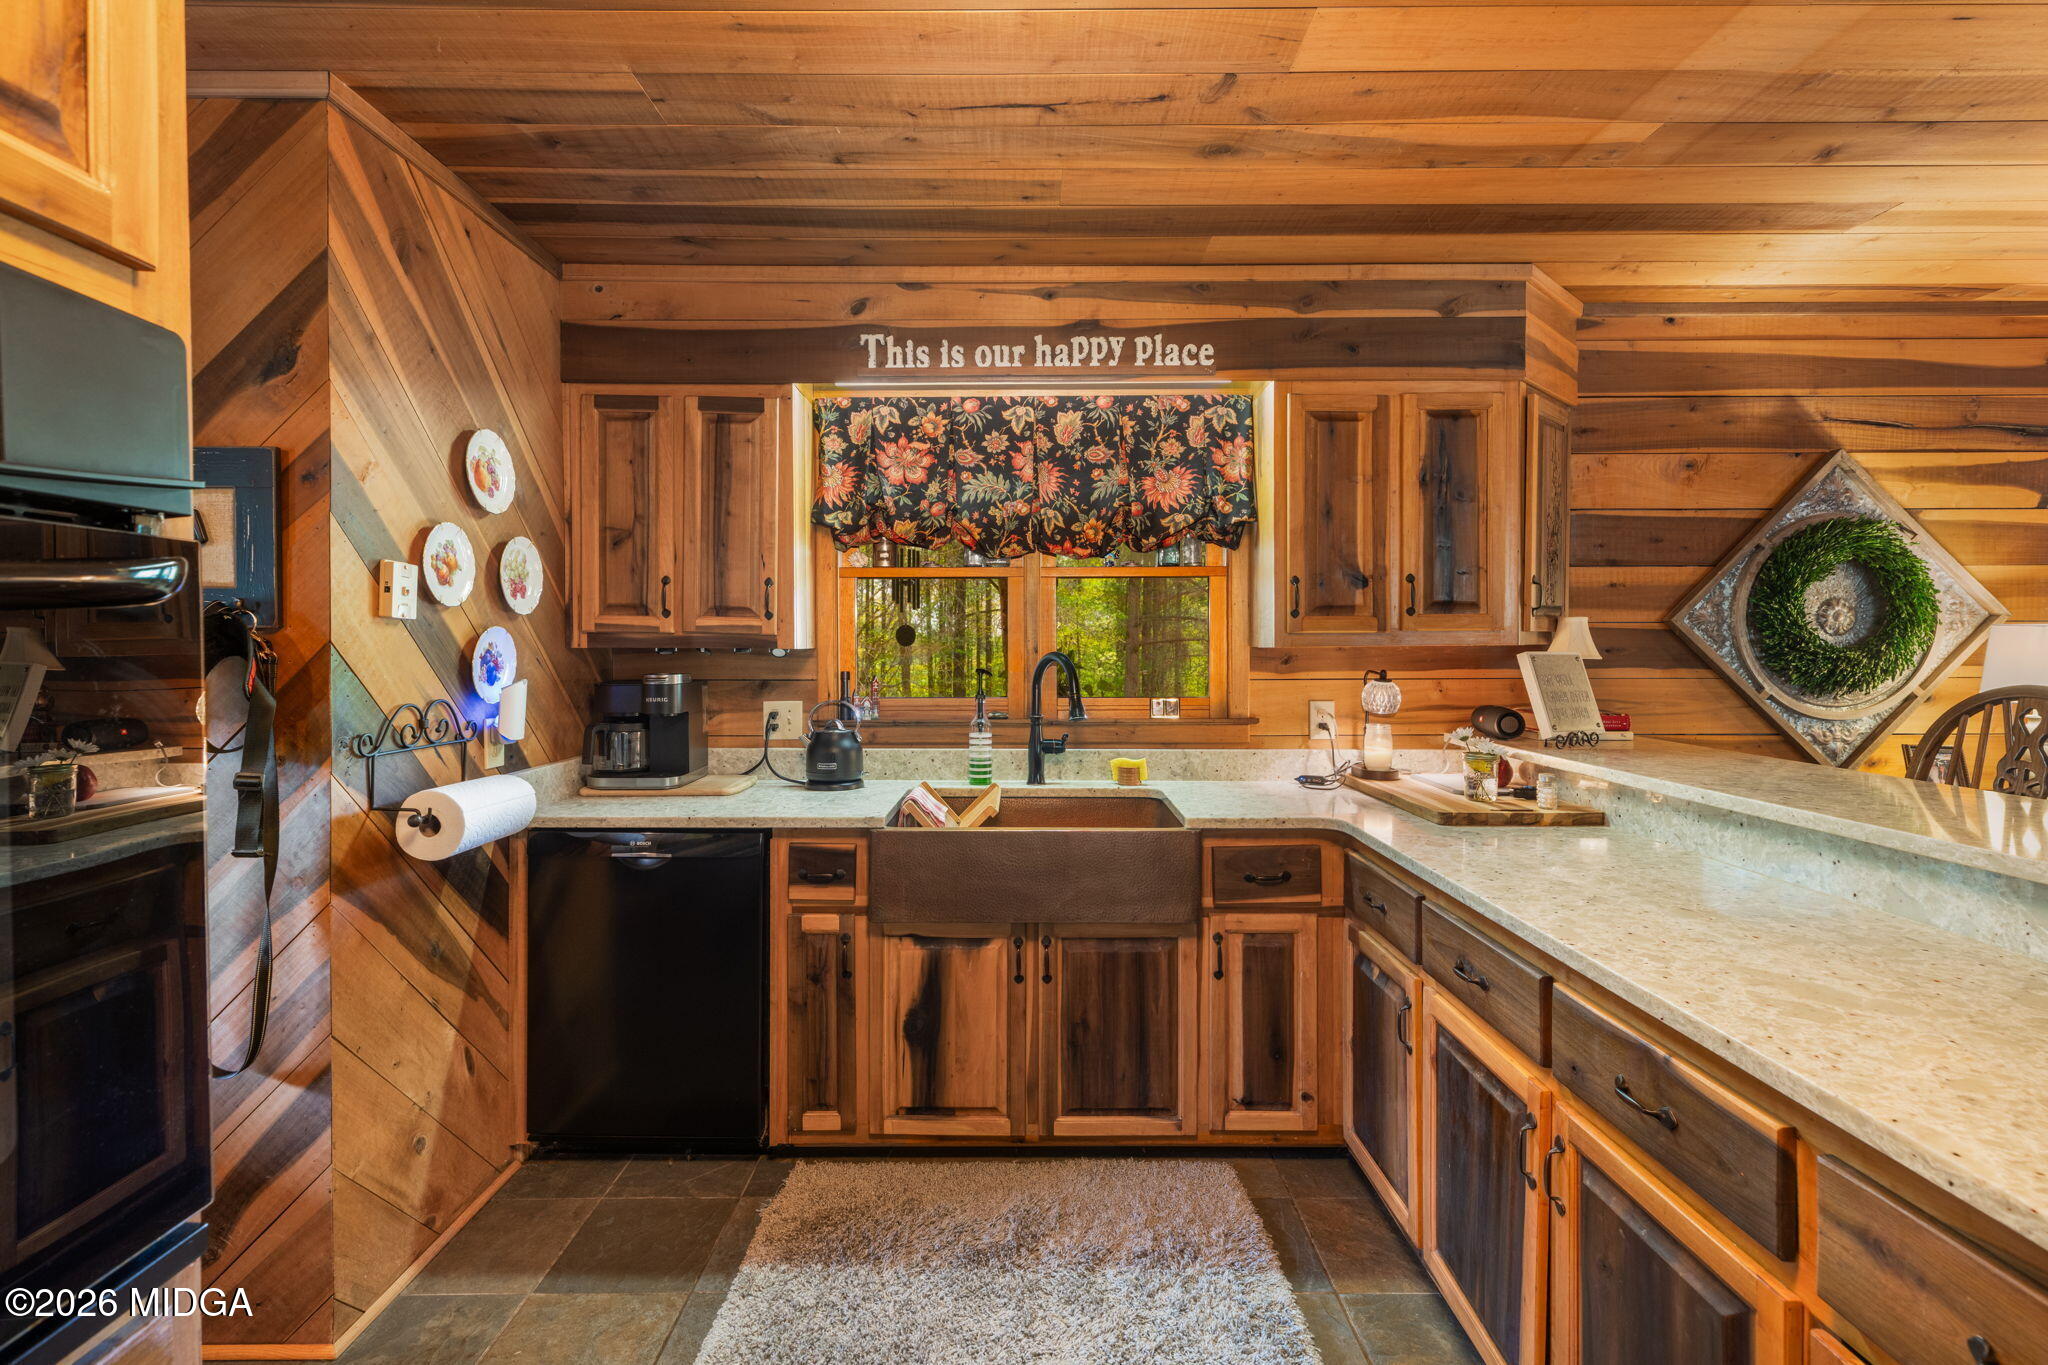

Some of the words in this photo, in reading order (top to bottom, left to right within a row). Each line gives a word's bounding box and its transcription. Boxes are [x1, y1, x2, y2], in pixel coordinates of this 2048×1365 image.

[860, 333, 931, 369] This
[940, 339, 965, 368] is
[974, 343, 1026, 368] our
